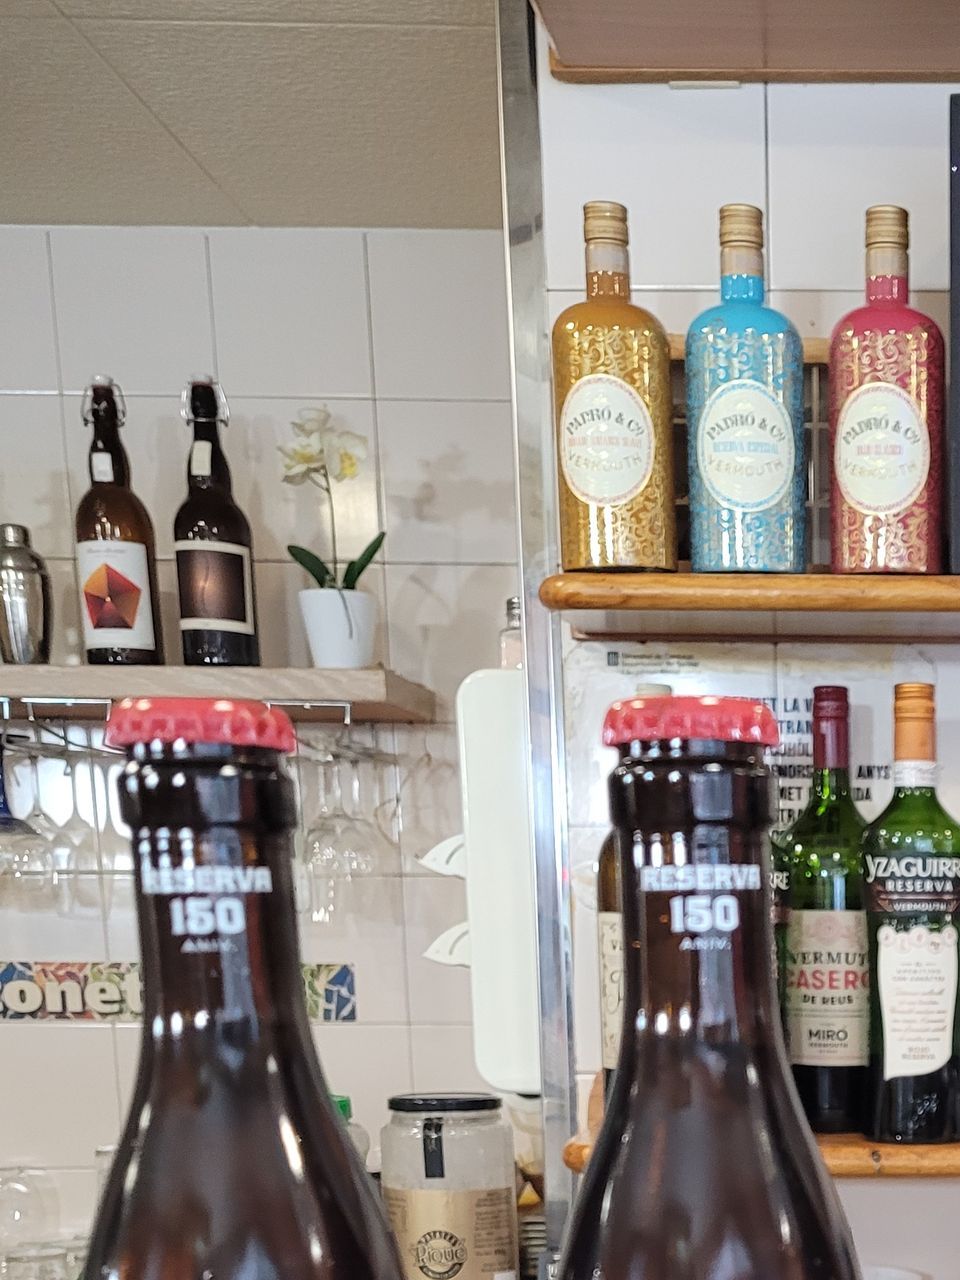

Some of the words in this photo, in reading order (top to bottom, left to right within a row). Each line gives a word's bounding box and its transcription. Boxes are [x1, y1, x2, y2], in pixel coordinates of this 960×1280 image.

[615, 412, 625, 425] &
[758, 417, 769, 430] &
[857, 765, 892, 780] ANYS
[640, 864, 762, 892] RESERVA
[885, 879, 953, 892] RESERVA
[169, 897, 246, 936] 150
[670, 894, 739, 933] 150
[803, 994, 817, 1005] DE
[822, 994, 854, 1006] REUS
[808, 1025, 848, 1041] MIRÓ
